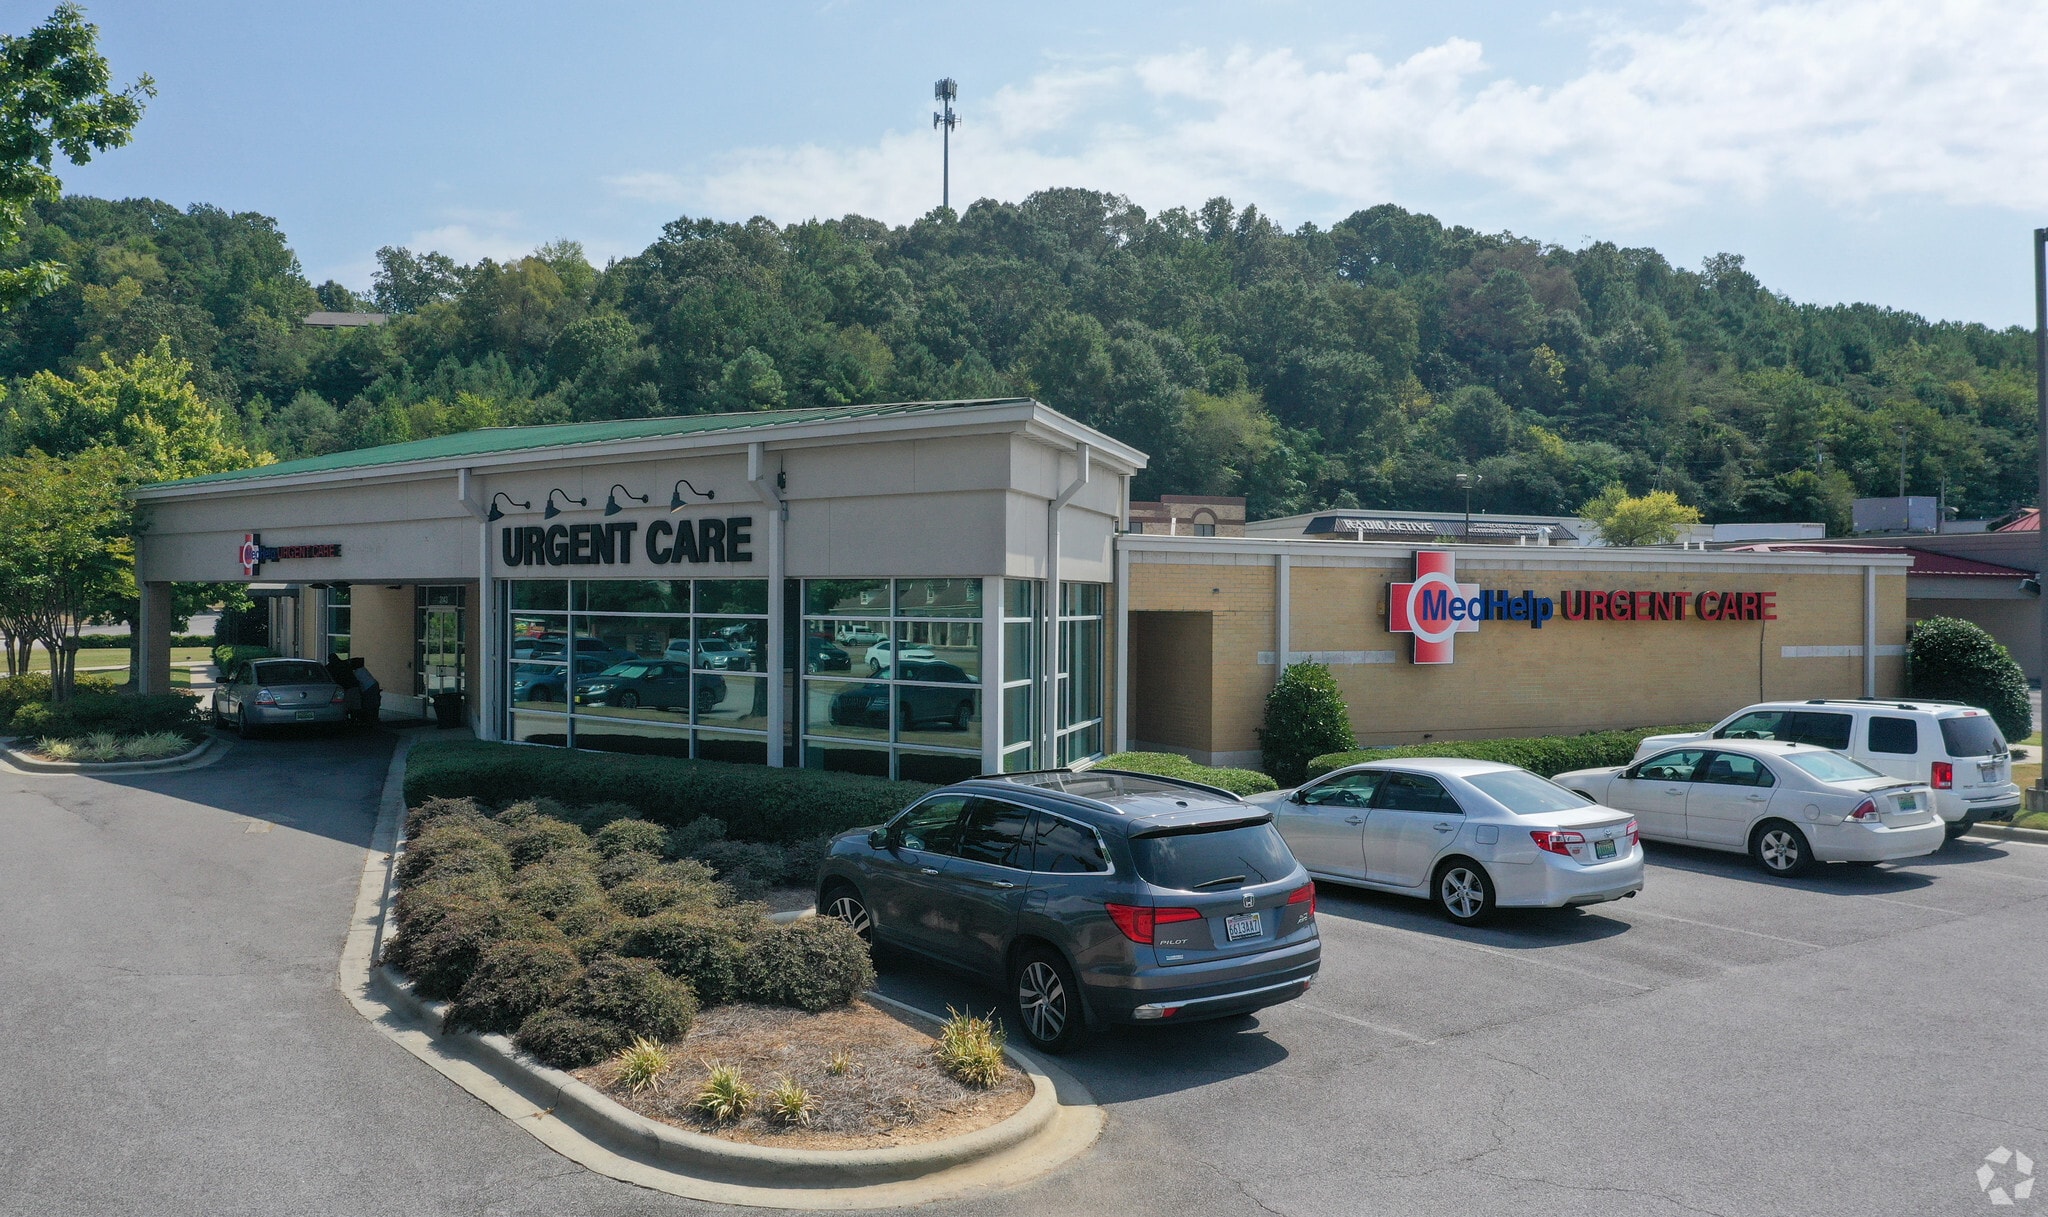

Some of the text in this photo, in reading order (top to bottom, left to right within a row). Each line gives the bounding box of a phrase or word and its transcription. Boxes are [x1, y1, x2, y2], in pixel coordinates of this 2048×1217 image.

[1387, 520, 1436, 532] ACTIVE
[502, 517, 753, 567] URGENT CARE
[278, 545, 310, 558] URGENT
[313, 544, 335, 557] CARE
[1422, 590, 1778, 629] MedHelp URGENT CARE
[1159, 938, 1188, 946] PILOT
